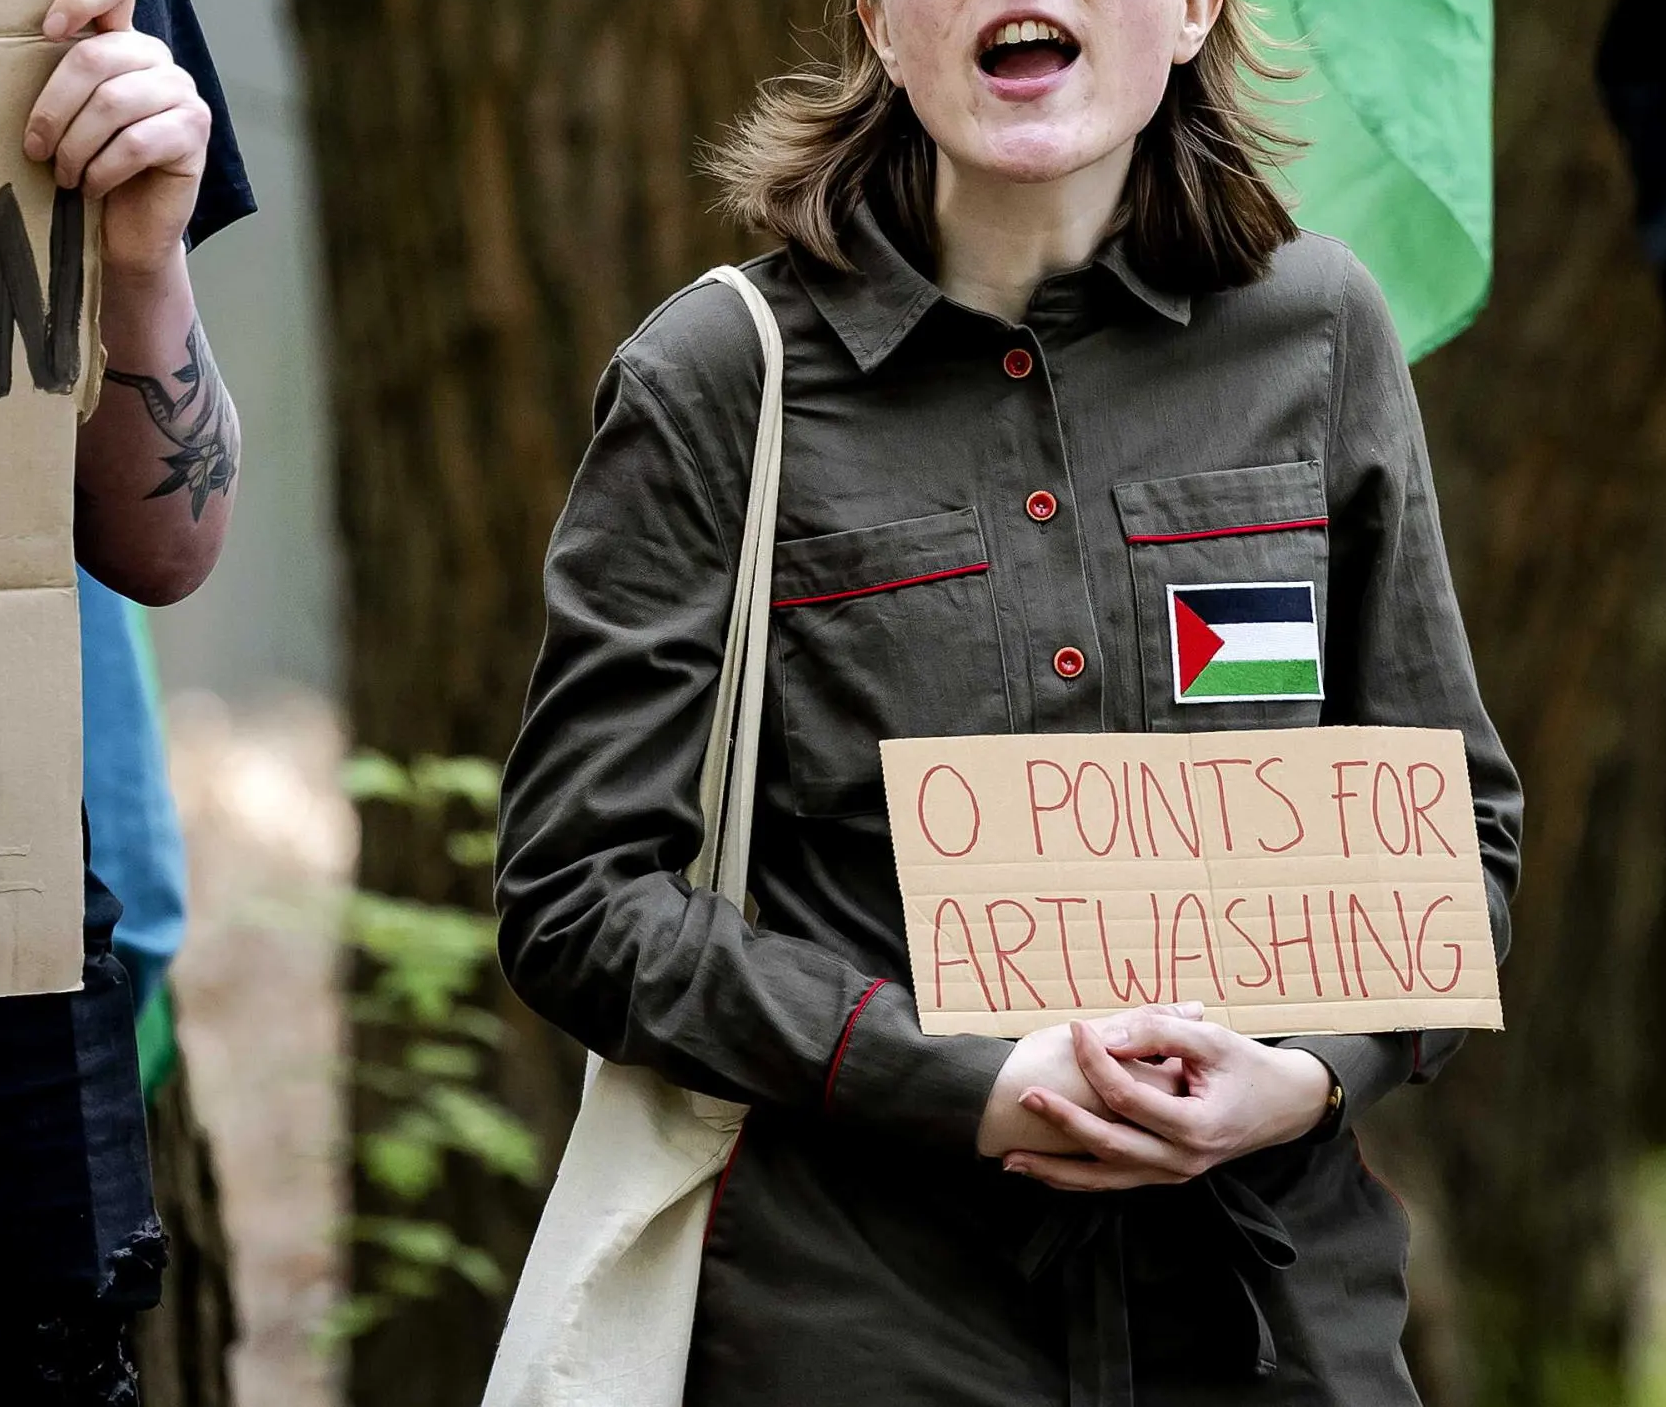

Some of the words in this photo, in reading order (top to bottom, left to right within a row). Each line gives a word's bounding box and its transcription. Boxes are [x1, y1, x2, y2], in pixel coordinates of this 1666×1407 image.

[1026, 757, 1305, 859] POINTS
[1331, 760, 1457, 859] FOR
[933, 889, 1463, 1013] ARTWASHING
